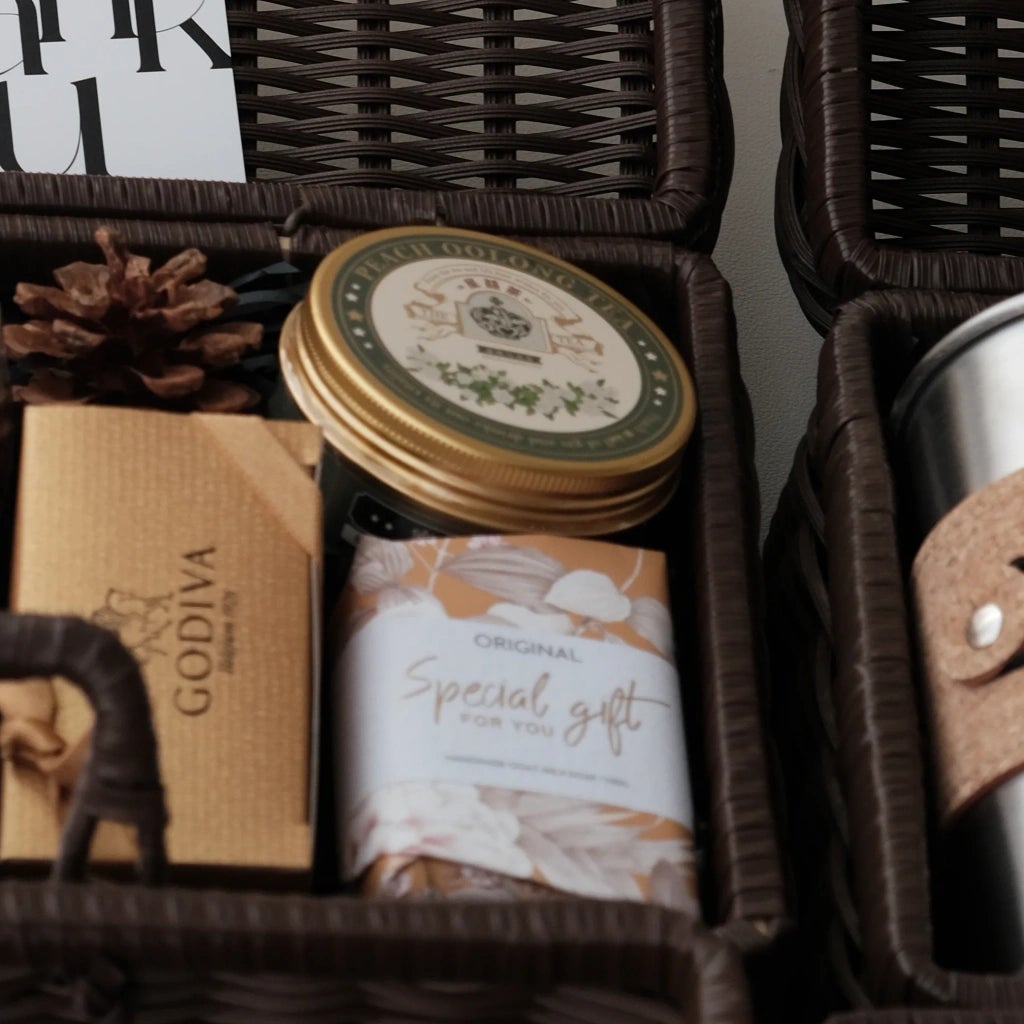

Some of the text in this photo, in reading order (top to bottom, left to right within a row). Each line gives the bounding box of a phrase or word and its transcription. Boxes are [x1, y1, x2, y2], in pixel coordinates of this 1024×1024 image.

[354, 242, 433, 281] PEACH
[441, 240, 577, 290] OOLONG
[585, 292, 636, 330] TEA
[174, 544, 217, 718] GODIVA
[473, 633, 583, 664] ORIGINAL
[400, 655, 672, 758] Special gift
[459, 713, 555, 739] FOR YOU
